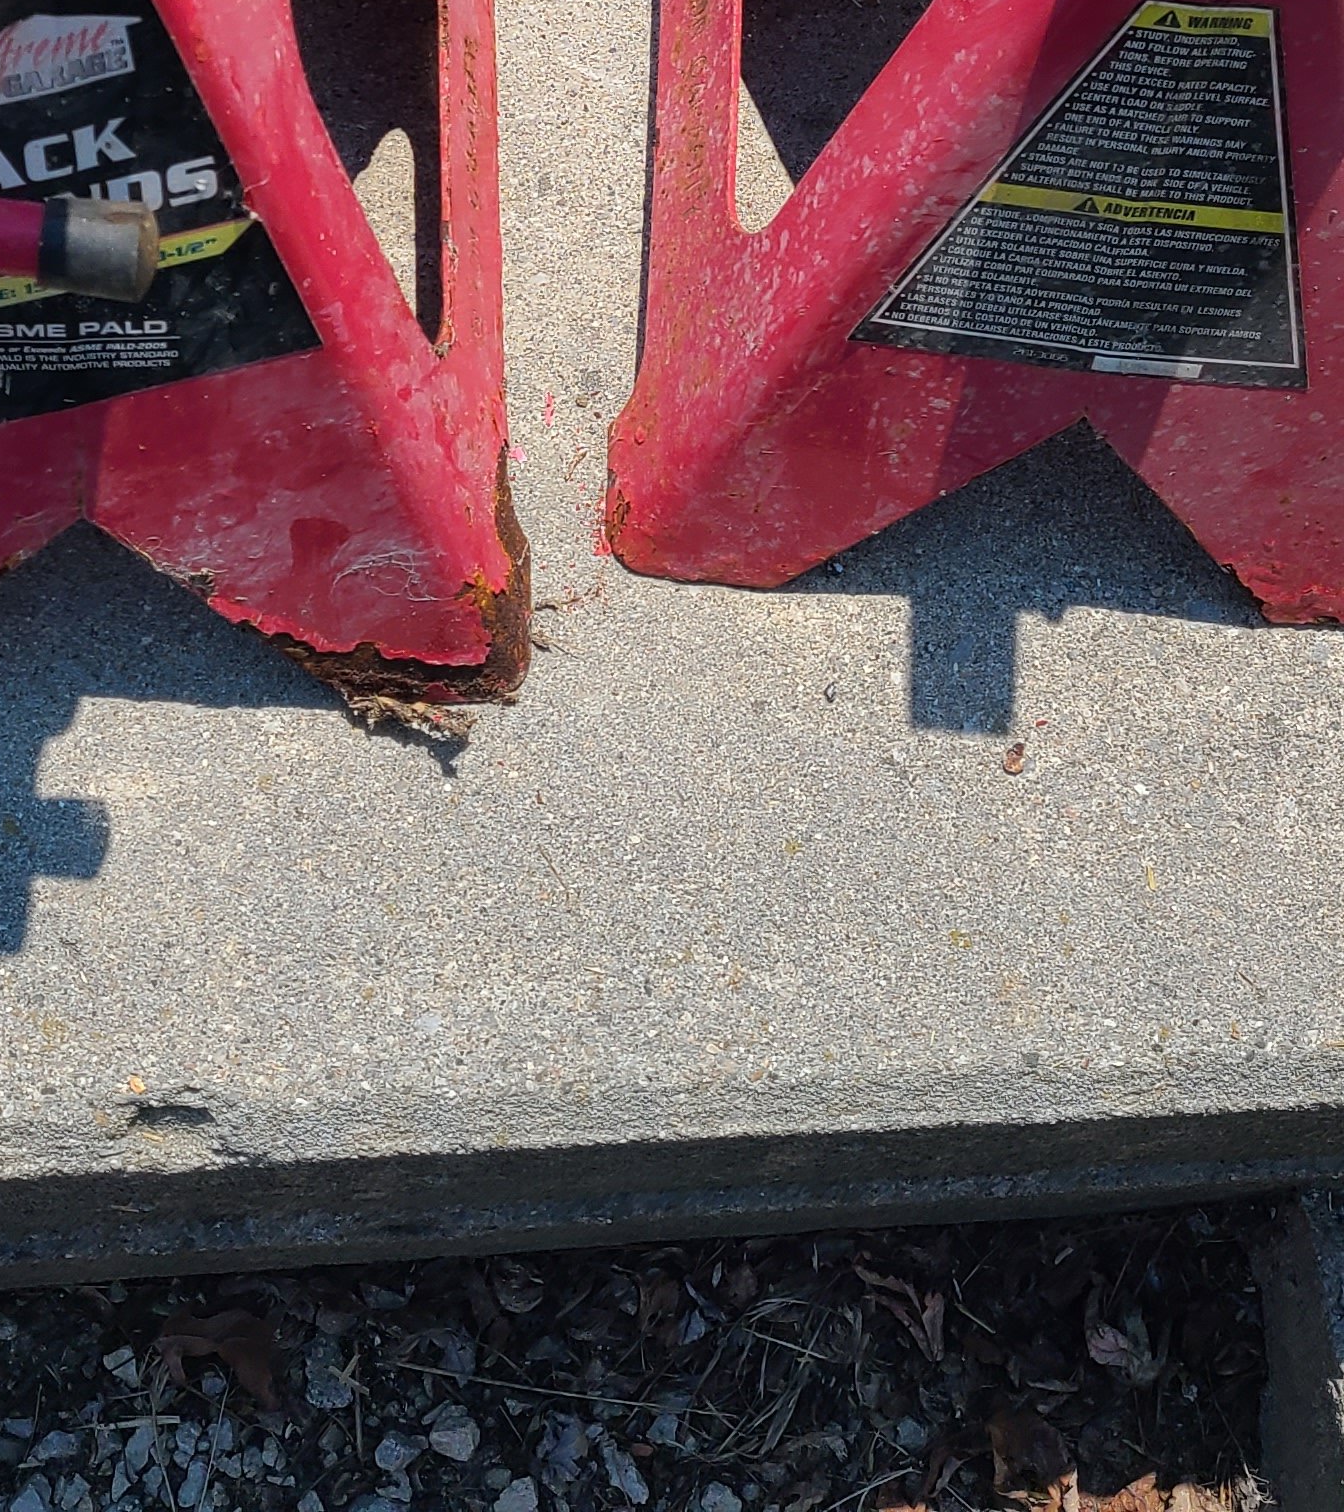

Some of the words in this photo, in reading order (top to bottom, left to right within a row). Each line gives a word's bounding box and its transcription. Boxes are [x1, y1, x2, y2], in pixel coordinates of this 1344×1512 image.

[1187, 16, 1254, 30] WARNING
[1123, 40, 1146, 50] AND
[1148, 43, 1189, 55] FOLLOW
[1191, 46, 1208, 56] ALL
[2, 45, 129, 97] GARAGE
[1109, 61, 1133, 72] THIS
[1134, 64, 1172, 77] DEVICE.
[1154, 54, 1193, 67] BEFORE
[1193, 58, 1248, 70] OPERATING
[1090, 82, 1111, 92] USE
[1111, 84, 1138, 95] ONLY
[1139, 88, 1154, 97] ON
[1193, 92, 1222, 102] LEVEL
[1099, 72, 1114, 81] DO
[1116, 73, 1136, 84] NOT
[1138, 76, 1176, 89] EXCEED
[1177, 81, 1208, 90] RATED
[1081, 92, 1119, 104] CENTER
[1121, 96, 1148, 108] LOAD
[1149, 101, 1164, 110] ON
[1064, 112, 1085, 122] ONE
[1086, 115, 1107, 125] END
[1108, 118, 1122, 126] OF
[1133, 121, 1170, 133] VEHICLE
[1072, 102, 1091, 112] USE
[1092, 105, 1107, 114] AS
[1118, 108, 1165, 121] MATCHED
[1191, 114, 1203, 123] TO
[1204, 115, 1251, 127] SUPPORT
[1046, 132, 1084, 145] RESULT
[1085, 137, 1096, 146] IN
[1098, 139, 1149, 155] PERSONAL
[1186, 148, 1224, 159] AND/OR
[1224, 151, 1276, 164] PROPERTY
[1054, 123, 1095, 135] FAILURE
[1097, 128, 1111, 137] TO
[1111, 130, 1138, 140] HEED
[1140, 133, 1171, 144] THESE
[1171, 136, 1223, 148] WARNINGS
[1225, 140, 1248, 149] MAY
[1020, 162, 1066, 176] SUPPORT
[1067, 168, 1095, 179] BOTH
[1095, 172, 1123, 183] ENDS
[1123, 176, 1139, 185] OR
[1163, 178, 1184, 188] SIDE
[1187, 182, 1202, 190] OF
[1028, 152, 1066, 165] STANDS
[1067, 157, 1089, 168] ARE
[1089, 161, 1111, 171] NOT
[1126, 165, 1140, 174] BE
[1140, 168, 1166, 177] USED
[1168, 168, 1181, 177] TO
[1011, 172, 1025, 181] NO
[1026, 175, 1091, 190] ALTERATIONS
[1093, 182, 1123, 194] SHALL
[1125, 188, 1137, 197] BE
[1140, 189, 1166, 199] MADE
[1168, 190, 1181, 199] TO
[1183, 192, 1205, 201] THIS
[1103, 202, 1196, 222] ADVERTENCIA
[963, 226, 978, 236] NO
[979, 228, 1023, 242] EXCEDER
[1024, 234, 1038, 243] LA
[970, 216, 984, 226] DE
[985, 218, 1019, 230] PONER
[1020, 223, 1034, 232] EN
[1034, 225, 1119, 245] FUNCIONAMIENTO
[1096, 222, 1120, 234] SIGA
[1122, 227, 1152, 236] TODAS
[1153, 228, 1172, 238] LAS
[1174, 230, 1248, 245] INSTRUCCIONES
[947, 245, 992, 259] COLOQUE
[993, 251, 1006, 260] LA
[1008, 254, 1040, 266] CARGA
[1042, 258, 1092, 272] CENTRADA
[1093, 266, 1124, 276] SOBRE
[1126, 269, 1137, 277] EL
[955, 236, 999, 249] UTILIZAR
[1000, 241, 1057, 257] SOLAMENTE
[1059, 249, 1090, 262] SOBRE
[1092, 254, 1113, 265] UNA
[1114, 258, 1168, 269] SUPERFICIE
[1169, 262, 1195, 272] DURA
[939, 255, 982, 268] UTILIZAR
[983, 261, 1013, 273] COMO
[1014, 265, 1035, 275] PAR
[1035, 267, 1095, 283] EQUIPARADO
[1096, 277, 1122, 287] PARA
[1123, 279, 1173, 291] SOPORTAR
[1174, 283, 1188, 292] UN
[1189, 284, 1234, 297] EXTREMO
[1235, 288, 1253, 298] DEL
[916, 283, 977, 299] PERSONALES
[1034, 299, 1047, 308] LA
[923, 274, 933, 282] SI
[934, 276, 949, 285] NO
[951, 277, 992, 290] RESPETA
[993, 283, 1024, 295] ESTAS
[1024, 288, 1094, 306] ADVERTENCIAS
[1132, 301, 1179, 313] RESULTAR
[1197, 306, 1243, 318] LESIONES
[79, 320, 168, 336] PALD
[899, 302, 950, 317] EXTREMOS
[961, 311, 974, 320] EL
[975, 313, 1018, 326] COSTADO
[1020, 319, 1033, 328] DE
[1035, 320, 1049, 330] UN
[906, 292, 926, 302] LAS
[927, 295, 958, 307] BASES
[959, 298, 973, 308] NO
[974, 301, 1006, 313] DEBEN
[1007, 306, 1061, 321] UTILIZARSE
[1153, 323, 1176, 333] PARA
[1178, 325, 1227, 337] SOPORTAR
[1228, 329, 1262, 339] AMBOS
[891, 311, 906, 321] NO
[951, 320, 1008, 334] REALIZARSE
[1008, 327, 1078, 345] ALTERACIONES
[1087, 338, 1110, 348] ESTE
[62, 352, 116, 362] INDUSTRY
[119, 350, 179, 359] STANDARD
[69, 343, 103, 353] ASME
[41, 361, 110, 371] AUTOMOTIVE
[112, 359, 171, 368] PRODUCTS
